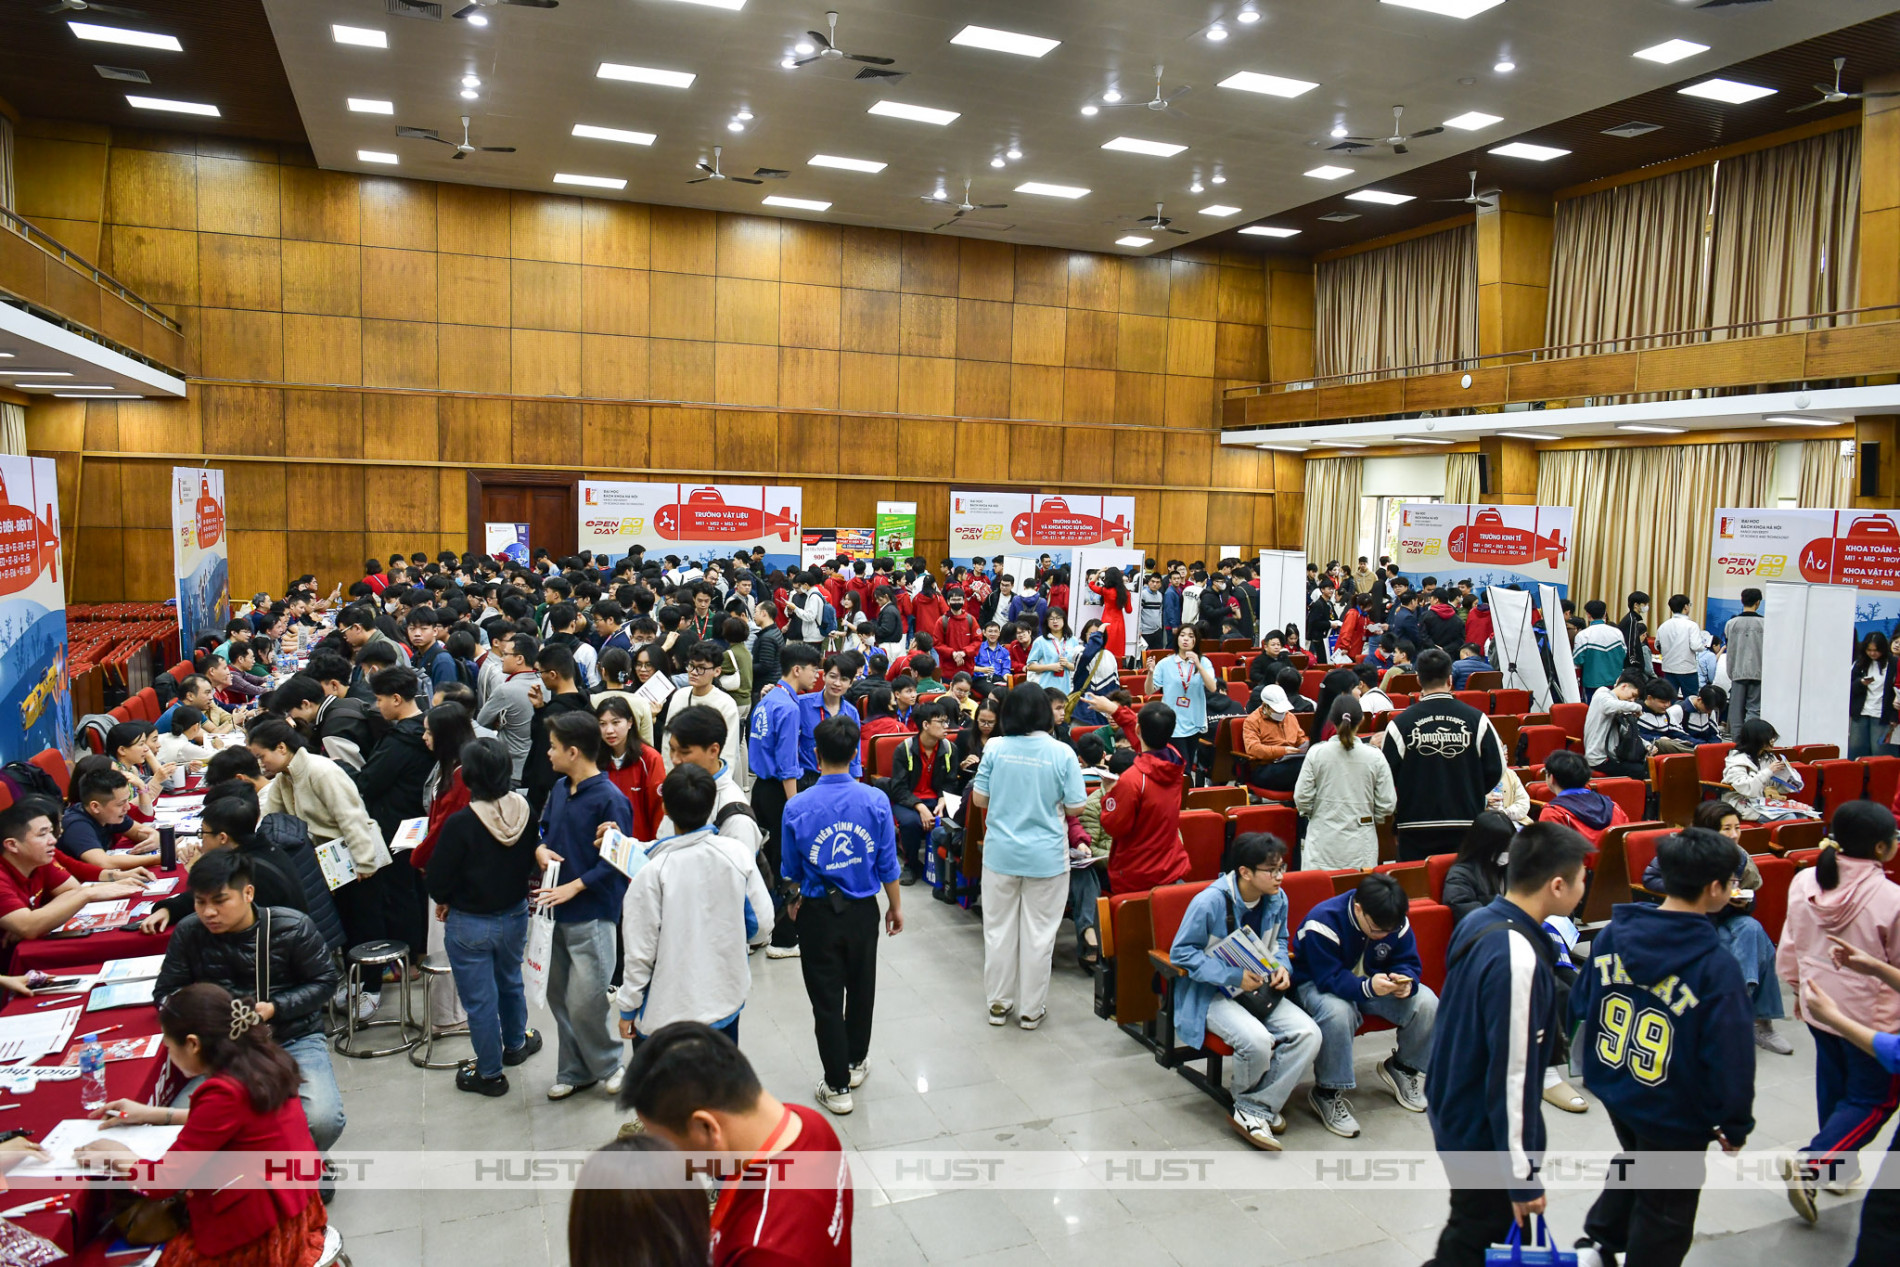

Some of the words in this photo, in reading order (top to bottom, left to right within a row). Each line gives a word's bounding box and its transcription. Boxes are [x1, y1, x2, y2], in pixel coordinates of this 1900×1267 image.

[1870, 545, 1892, 553] TOÁN
[1718, 557, 1756, 566] OPEN
[1761, 556, 1783, 565] 20
[1726, 567, 1755, 575] DAY
[1760, 567, 1781, 575] 25
[1867, 568, 1883, 577] VẬT
[833, 820, 853, 832] TÌNH
[814, 826, 833, 844] VIÊN
[809, 844, 820, 865] SINH
[1594, 953, 1700, 1016] TAAT
[1596, 992, 1674, 1086] 99
